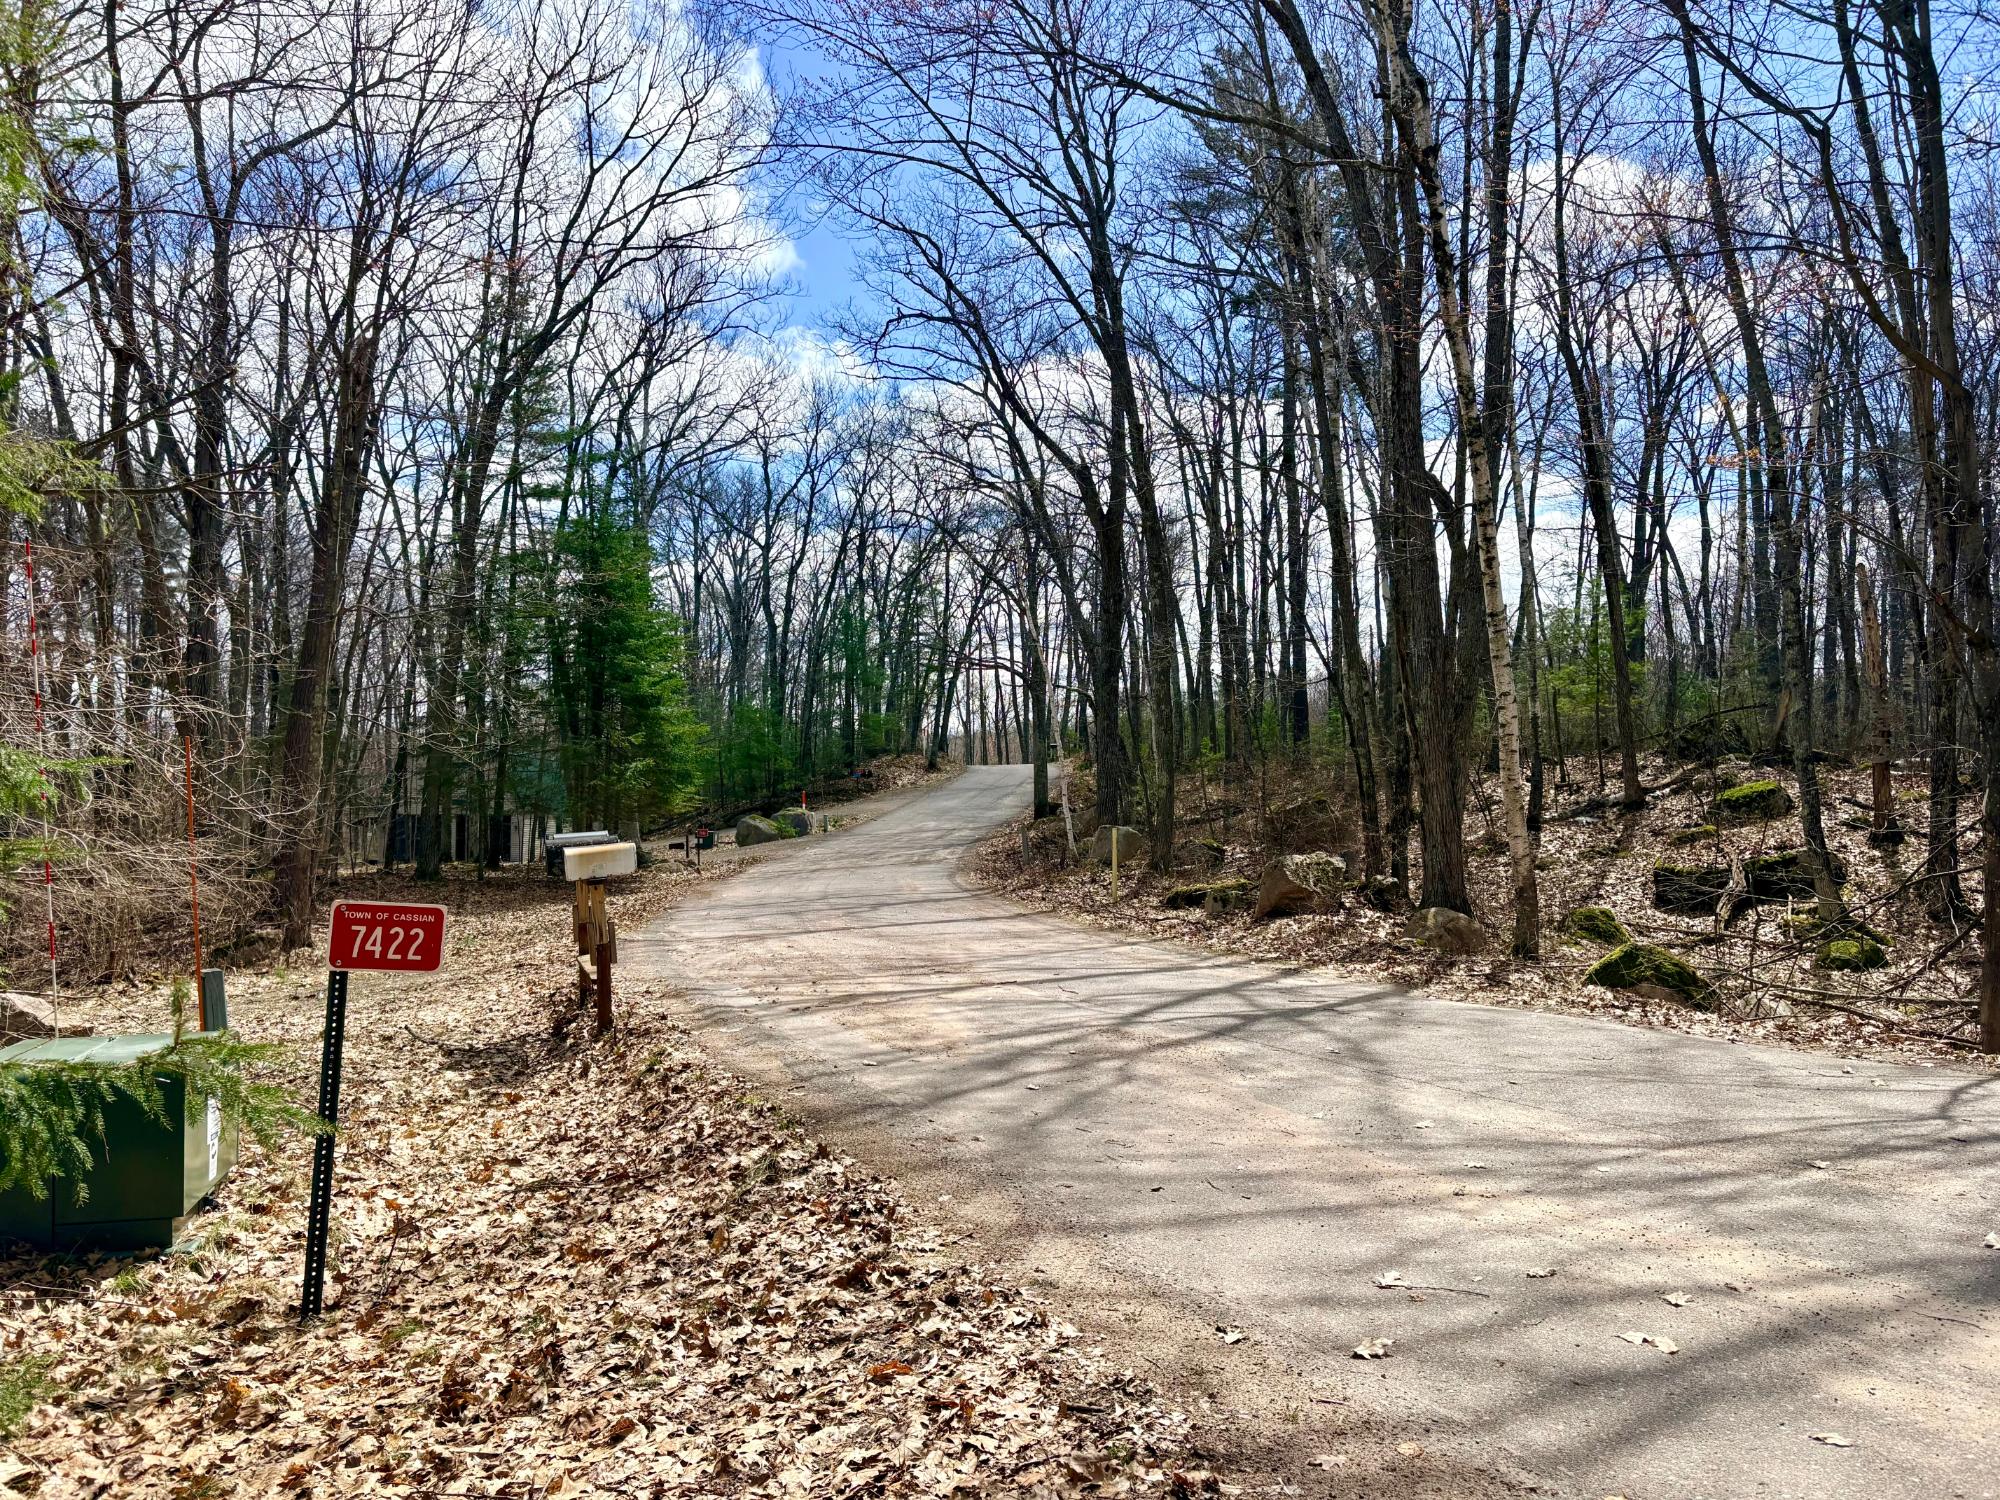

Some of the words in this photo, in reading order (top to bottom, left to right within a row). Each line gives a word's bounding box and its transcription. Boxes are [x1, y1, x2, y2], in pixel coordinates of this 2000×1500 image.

[344, 911, 371, 919] TOWN
[376, 912, 389, 920] OF
[393, 913, 435, 922] CASSIAN
[351, 925, 424, 960] 7422
